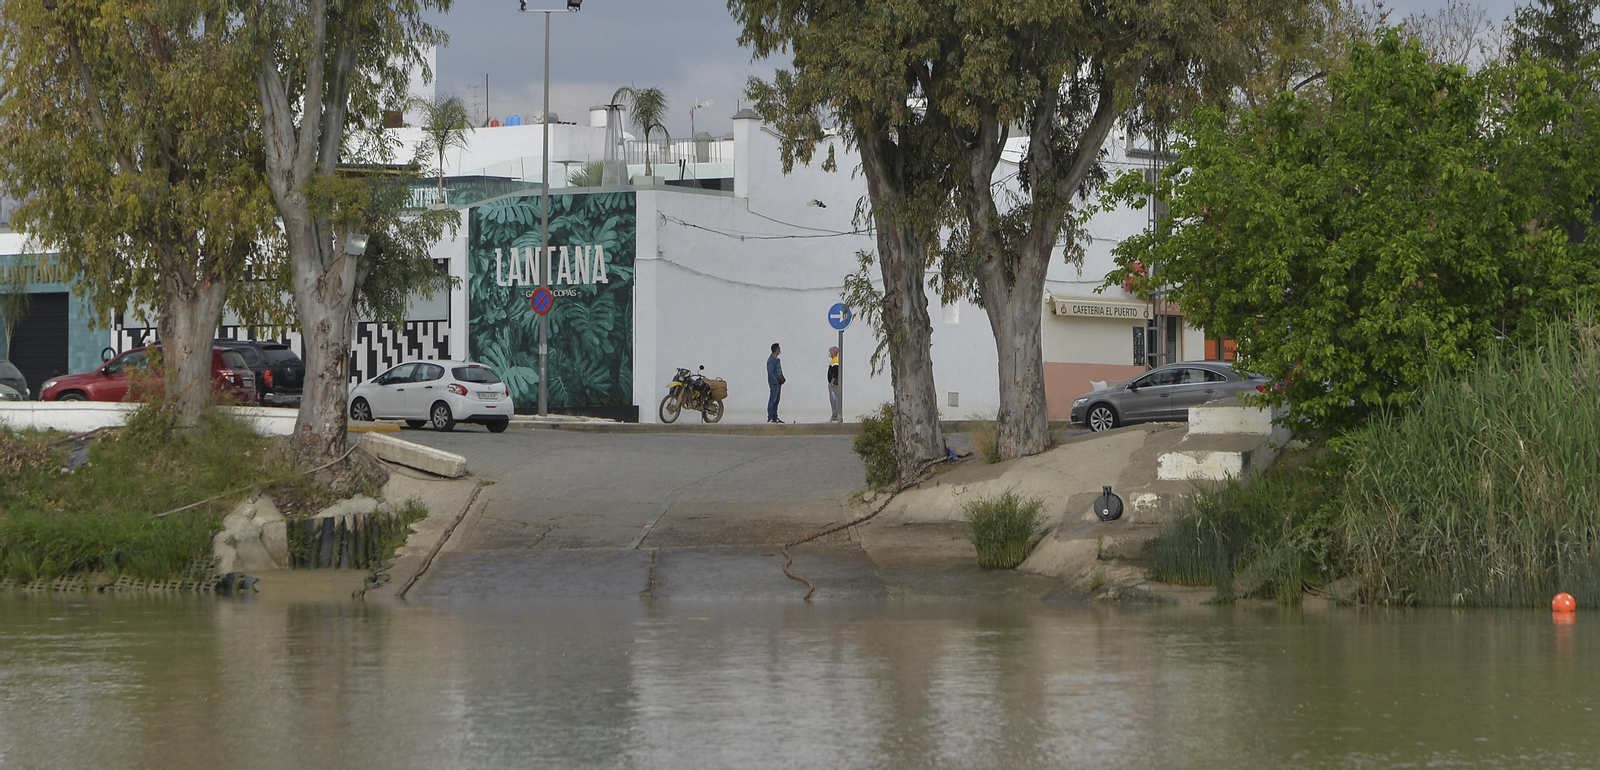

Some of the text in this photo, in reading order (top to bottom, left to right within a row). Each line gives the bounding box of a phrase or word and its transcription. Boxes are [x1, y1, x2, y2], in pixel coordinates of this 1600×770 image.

[495, 245, 609, 286] LANTANA
[553, 289, 577, 298] COPAS
[1072, 304, 1138, 318] CAFETERIA EL PUERTO
